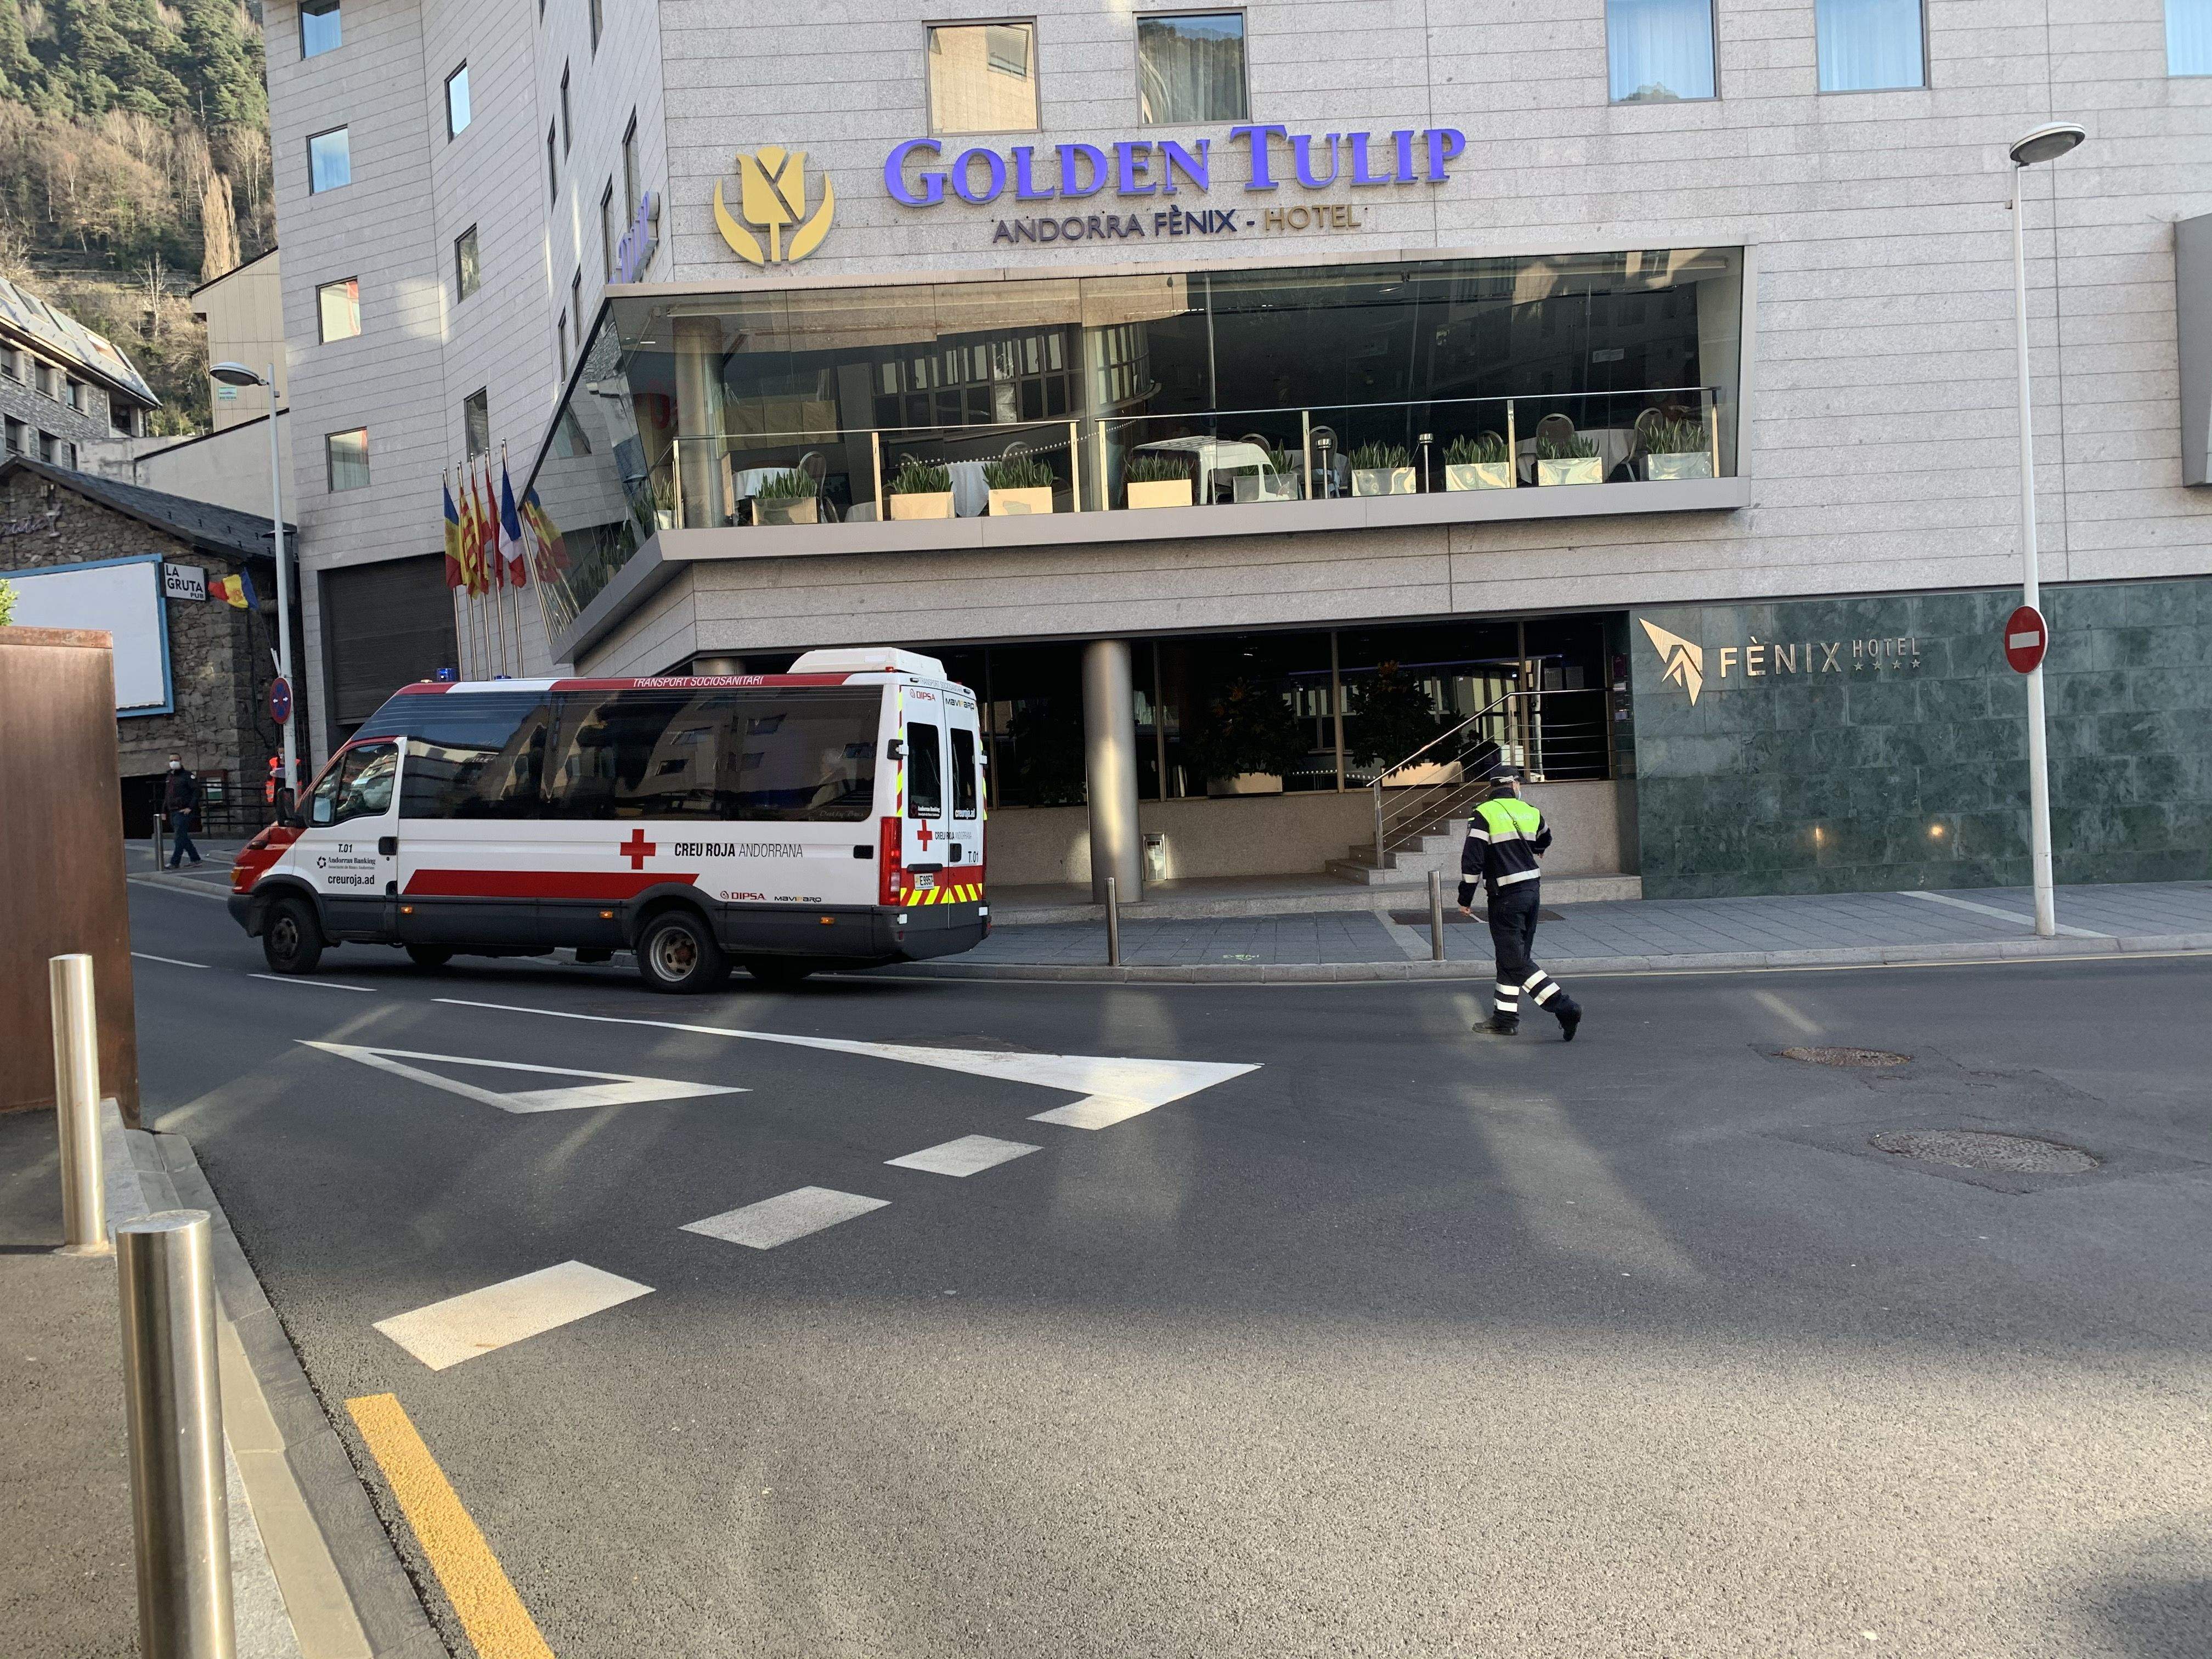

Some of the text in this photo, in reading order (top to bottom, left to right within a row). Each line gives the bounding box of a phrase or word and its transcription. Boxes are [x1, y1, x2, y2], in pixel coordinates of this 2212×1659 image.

[884, 124, 1466, 207] GOLDEN TULIP
[994, 212, 1145, 243] ANDORRA
[1154, 205, 1238, 235] FÈNIX
[1265, 204, 1362, 230] HOTEL
[166, 565, 179, 577] LA
[167, 578, 204, 592] GRUTA
[1720, 636, 1920, 678] FÈNIX HOTEL
[633, 675, 765, 687] TRANSPORT SOCIOSANITARI
[916, 691, 936, 702] DIPSA
[338, 844, 353, 853] T.01
[674, 843, 803, 858] CREU ROJA ANDORRANA
[354, 857, 376, 865] Banking
[968, 851, 979, 863] T.01
[328, 874, 375, 887] creuroja.ad
[731, 892, 766, 900] DIPSA
